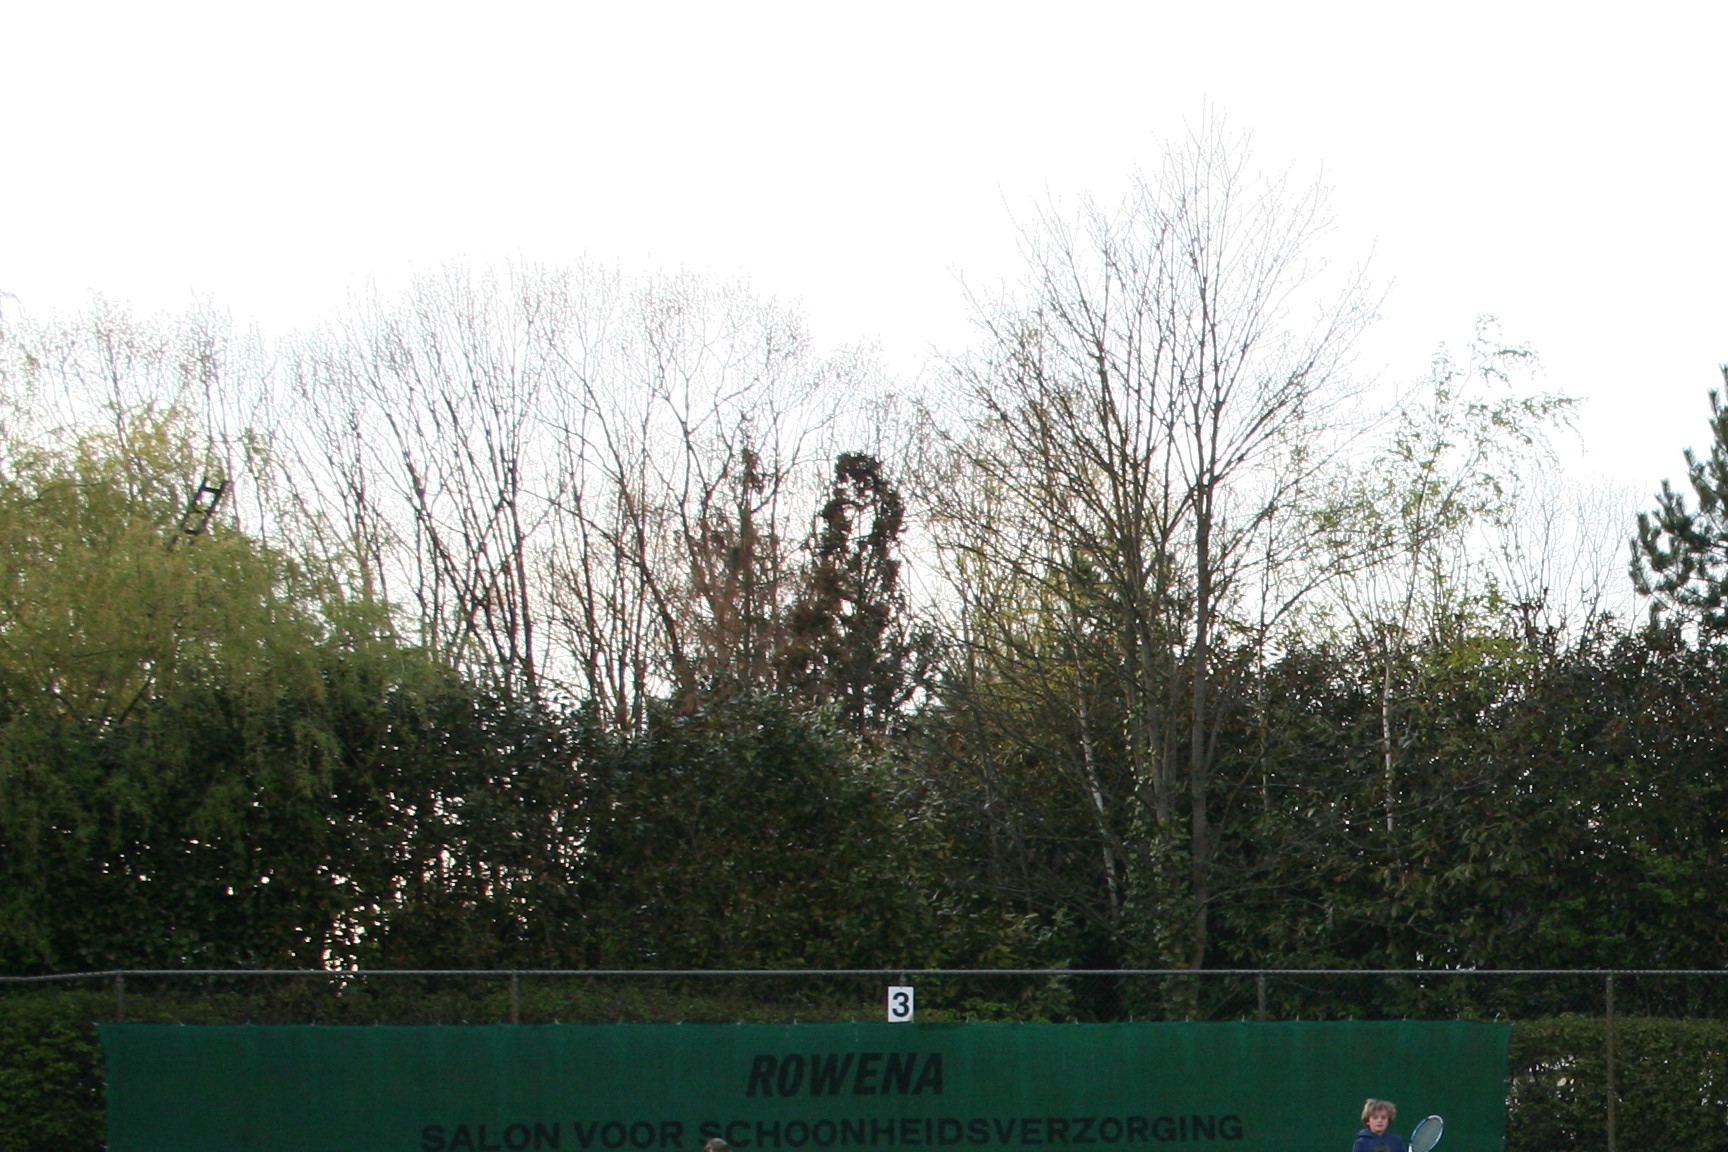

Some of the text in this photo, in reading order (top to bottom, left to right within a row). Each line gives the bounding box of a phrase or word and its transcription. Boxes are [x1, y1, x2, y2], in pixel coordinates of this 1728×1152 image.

[892, 991, 910, 1018] 3
[746, 1052, 945, 1098] ROWENA
[420, 1113, 1244, 1152] SALON VOOR SCHOONHEIDSVERZORGING
